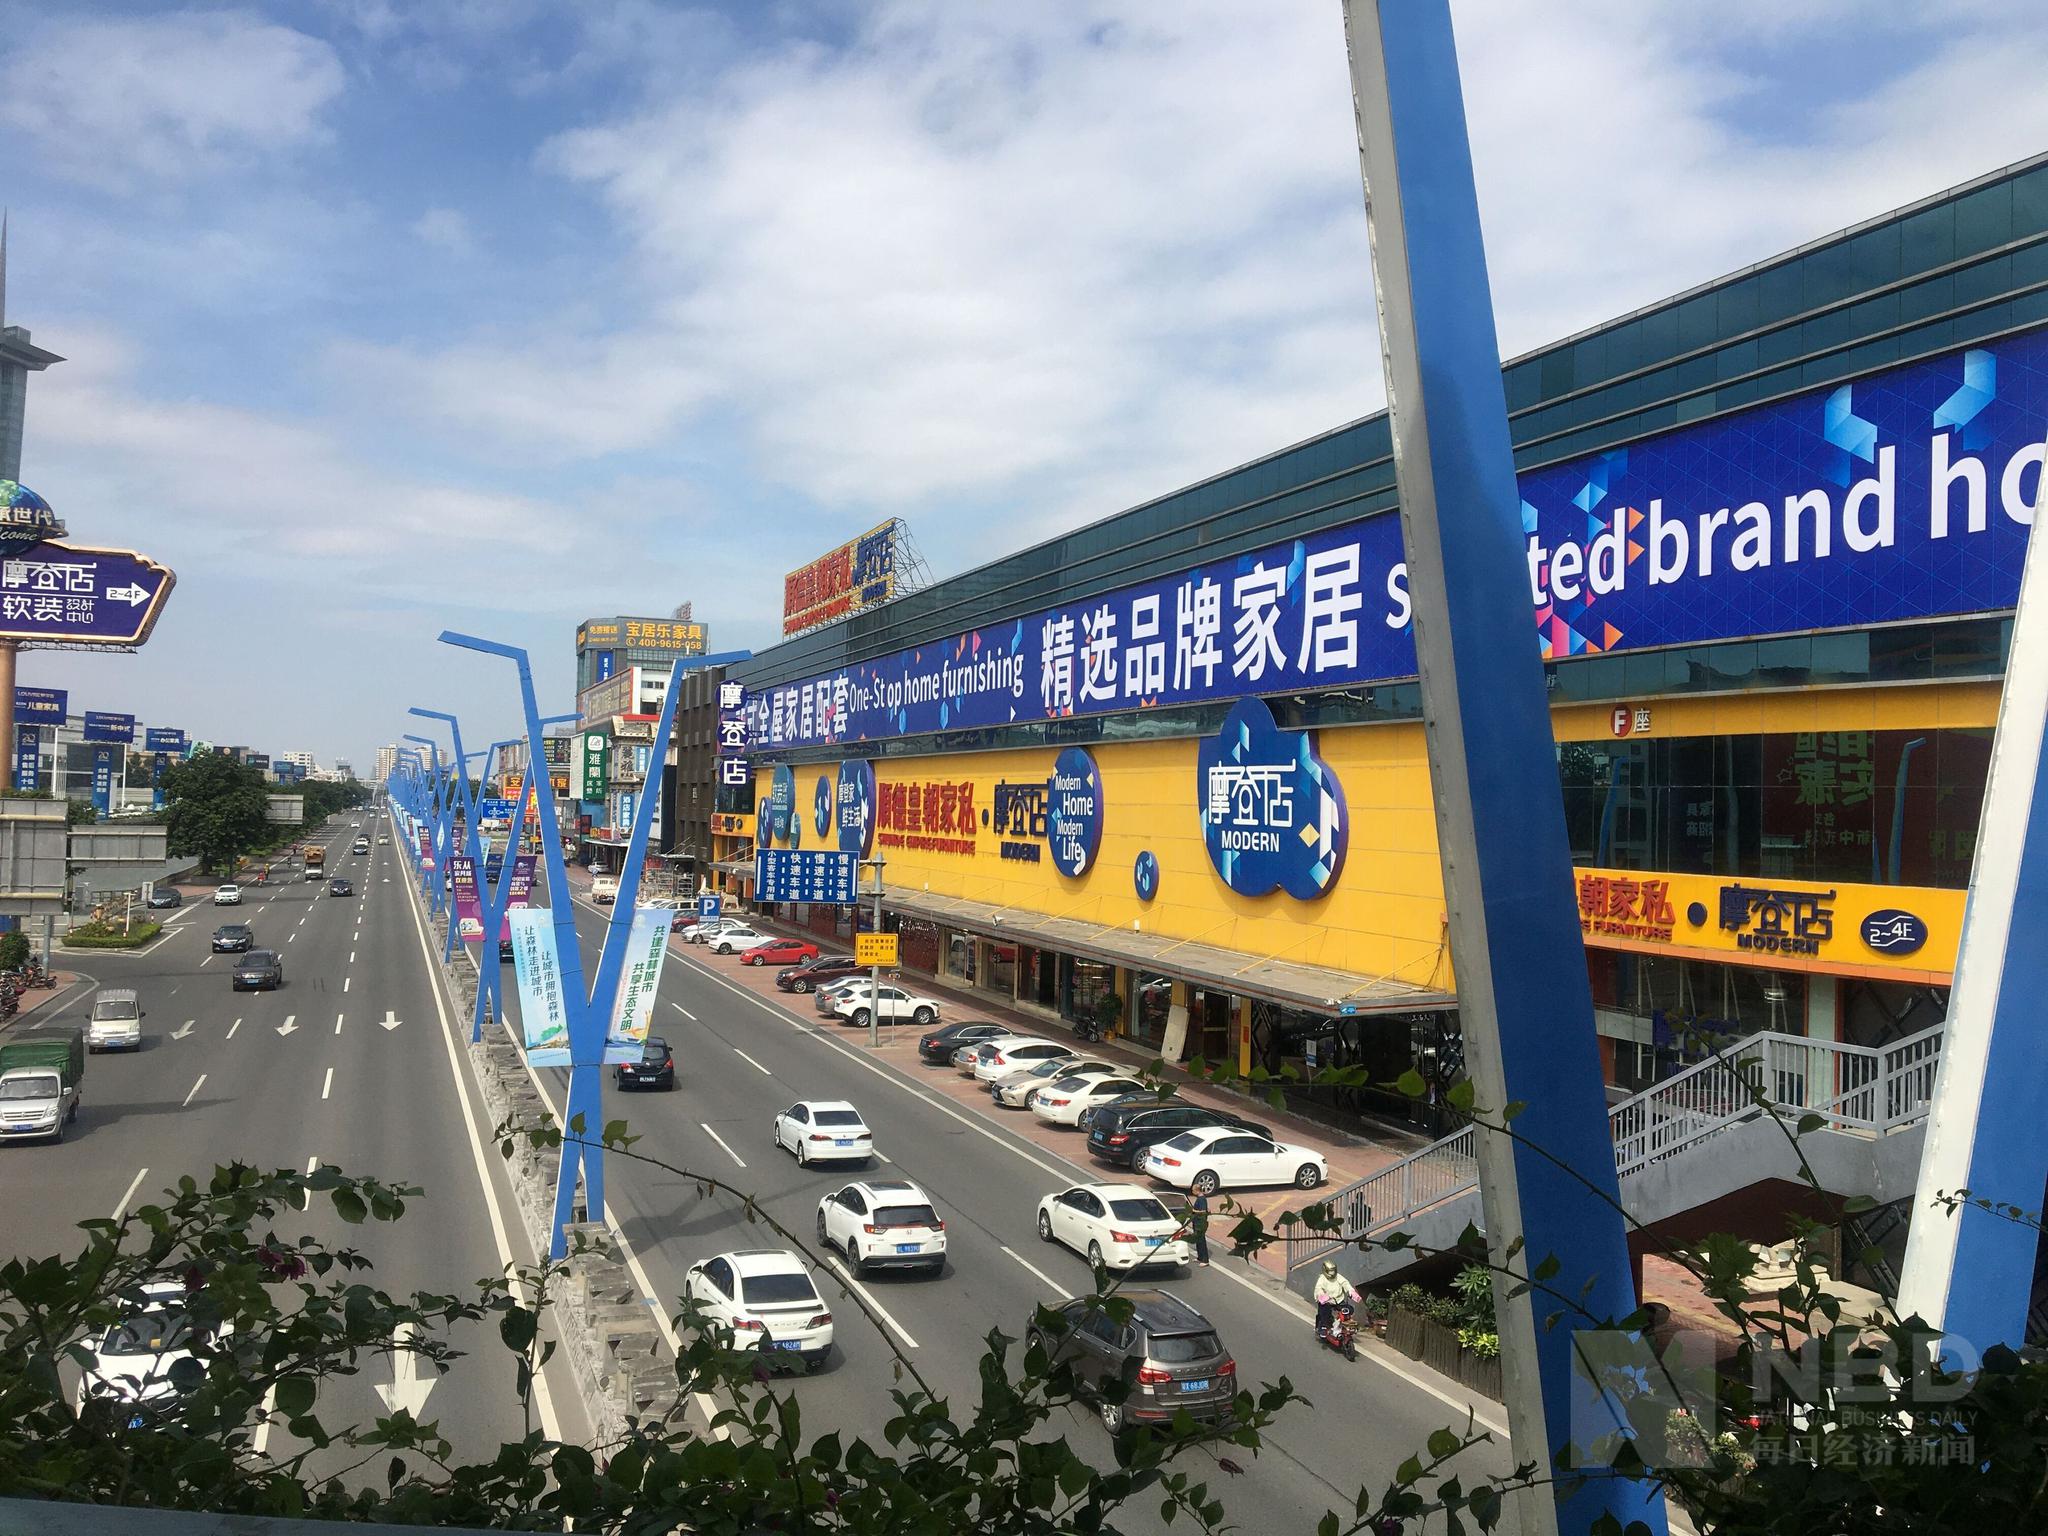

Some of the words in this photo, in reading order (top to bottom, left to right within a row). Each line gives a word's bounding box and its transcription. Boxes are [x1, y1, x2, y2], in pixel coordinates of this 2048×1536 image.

[1649, 445, 1895, 585] brand
[2, 558, 98, 592] 摩登店
[2, 595, 63, 622] 软装
[626, 621, 702, 640] 宝居乐家具
[1041, 543, 1362, 708] 精选品牌家居
[904, 670, 940, 705] home
[943, 647, 1024, 698] furnishing
[720, 682, 749, 784] 摩登店
[1055, 773, 1081, 791] Modern
[1063, 792, 1094, 816] Home
[1208, 758, 1297, 829] 摩登店
[1057, 818, 1083, 836] Modern
[1063, 835, 1082, 861] Life
[1221, 830, 1280, 852] MODERN
[766, 851, 777, 900] 小型客车专用道
[789, 853, 802, 900] 快速车道
[813, 854, 826, 900] 慢速车道
[837, 854, 849, 900] 慢速车道
[703, 899, 715, 915] P
[1577, 875, 1676, 925] 朝家私
[1719, 883, 1837, 940] 摩登店
[1594, 920, 1672, 941] FURNITURE
[1738, 933, 1820, 955] MODERN
[641, 925, 666, 992] 共建森林城市
[541, 951, 559, 1021] 让城市拥抱森林
[620, 962, 645, 1031] 共享生态文明
